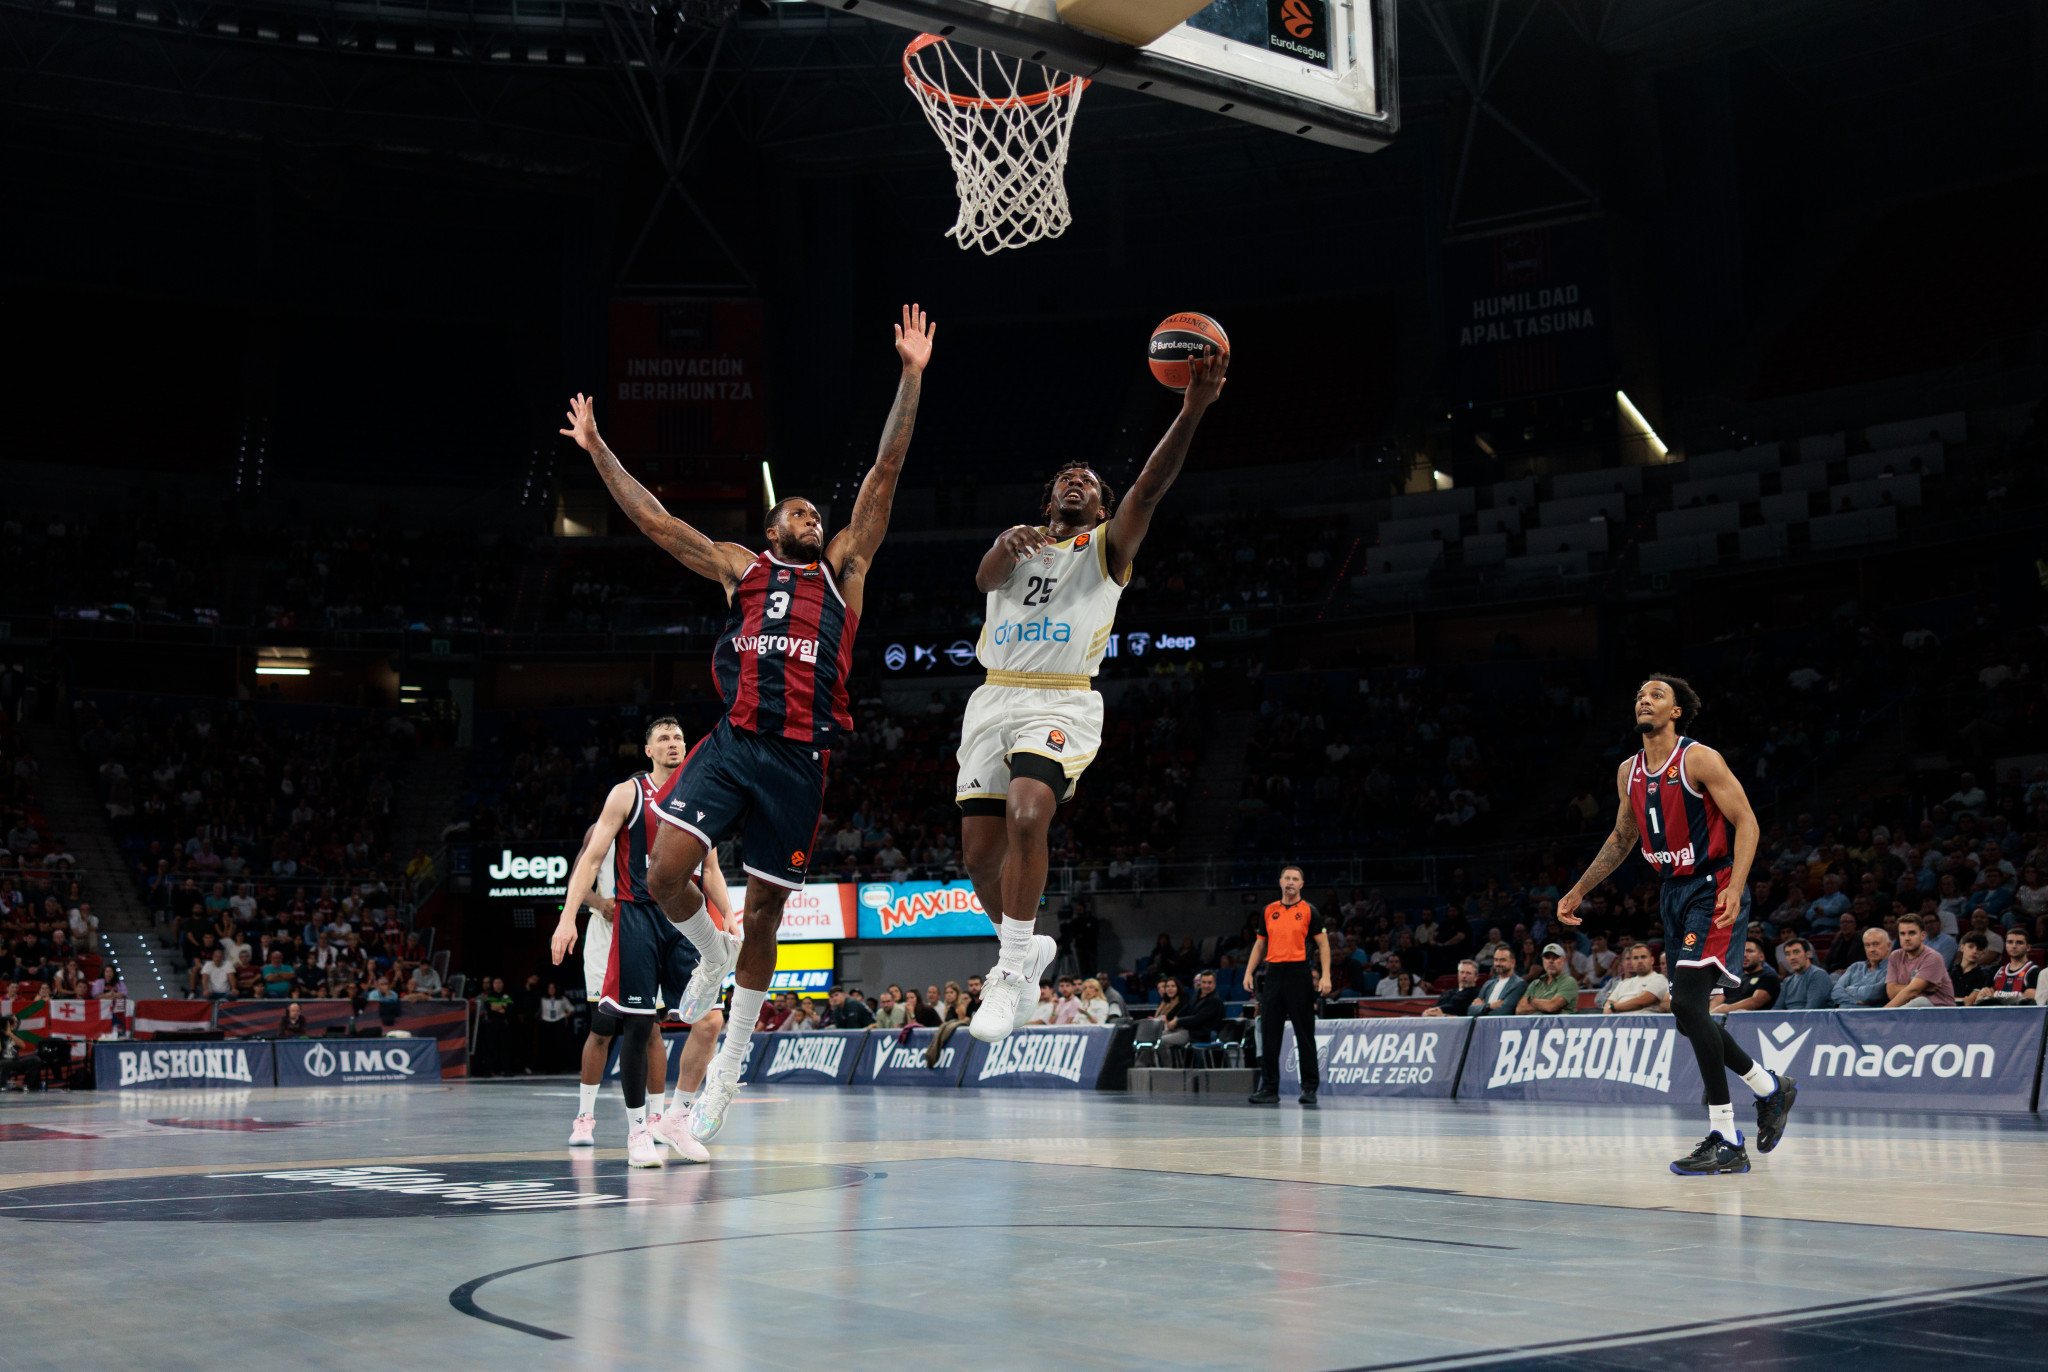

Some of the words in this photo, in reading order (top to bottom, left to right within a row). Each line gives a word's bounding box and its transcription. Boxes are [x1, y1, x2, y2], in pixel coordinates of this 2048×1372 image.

[1270, 34, 1326, 60] EuroLeague
[1471, 283, 1580, 320] HUMILDAD
[1459, 306, 1596, 347] APALTASUNA
[1157, 340, 1204, 352] EuroLeague
[627, 353, 744, 377] INNOVACIÓN
[617, 381, 754, 400] BERRIHUNTZA
[1022, 575, 1058, 606] 25
[766, 591, 791, 619] 3
[994, 616, 1071, 645] dnata
[731, 634, 820, 663] kingroyal
[1103, 634, 1120, 658] AT
[1155, 634, 1196, 651] Jeep
[671, 798, 686, 809] Jeep
[1648, 807, 1660, 834] 1
[488, 849, 569, 885] Jeep
[488, 887, 520, 898] ALAVA
[520, 886, 568, 897] LASCARAY
[783, 892, 820, 909] adio
[781, 910, 831, 926] itoria
[878, 888, 987, 935] MAXIBO
[339, 1048, 416, 1075] IMQ
[766, 1036, 847, 1078] BASKONIA
[889, 1047, 956, 1068] macon
[978, 1034, 1088, 1083] BASKONIA
[1330, 1032, 1438, 1064] AMBAR
[1486, 1027, 1676, 1094] BASKONIA
[1808, 1043, 1996, 1079] macron
[118, 1048, 253, 1086] BASKONIA
[1327, 1067, 1383, 1084] TRIPLE
[1384, 1066, 1433, 1085] ZERO
